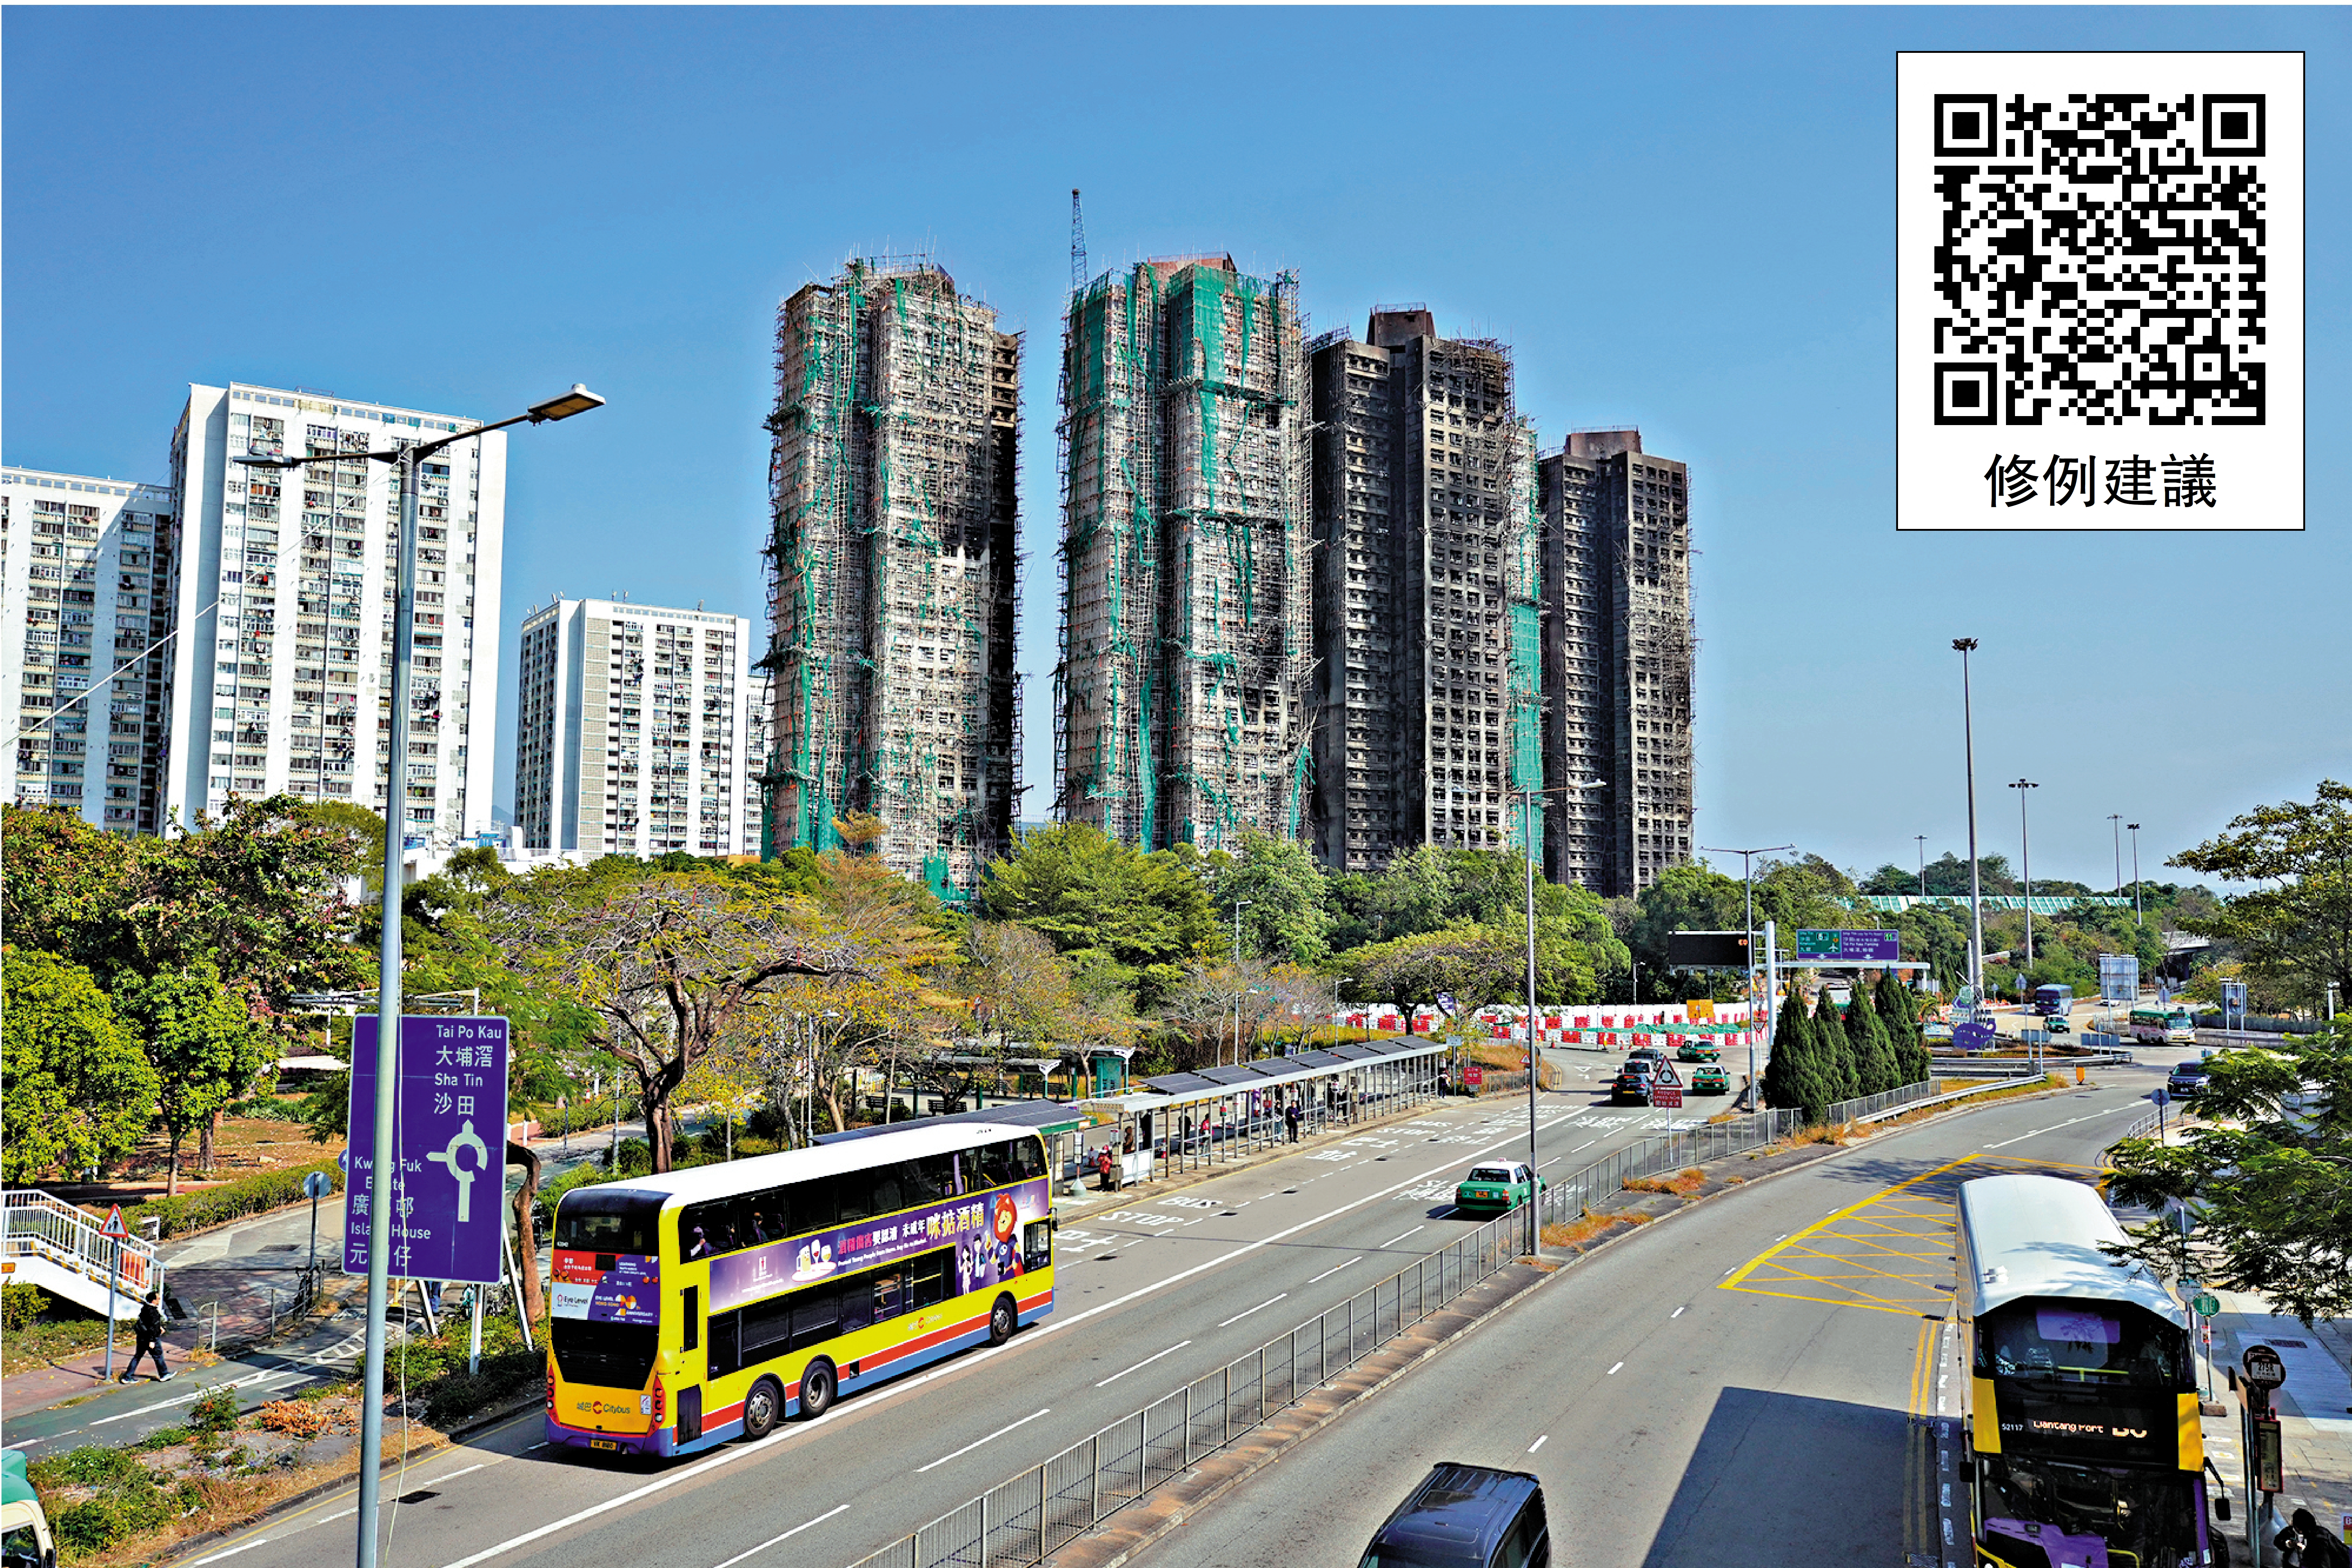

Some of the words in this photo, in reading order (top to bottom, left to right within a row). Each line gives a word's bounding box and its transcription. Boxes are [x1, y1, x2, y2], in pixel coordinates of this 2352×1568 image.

[436, 1025, 454, 1039] Tai
[458, 1025, 474, 1039] Po
[478, 1026, 502, 1039] Kau
[436, 1045, 493, 1068] 大埔滘
[434, 1072, 458, 1087] Sha
[464, 1073, 483, 1087] Tin
[434, 1092, 475, 1116] 沙田
[355, 1156, 394, 1173] Kwg
[401, 1158, 422, 1173] Fuk
[366, 1176, 405, 1191] Ete
[352, 1194, 414, 1218] 廣邨
[1157, 1196, 1223, 1209] BUS
[1098, 1211, 1184, 1226] STOP
[392, 1224, 431, 1239] House
[350, 1242, 412, 1267] 元仔
[603, 1403, 631, 1414] Citybus
